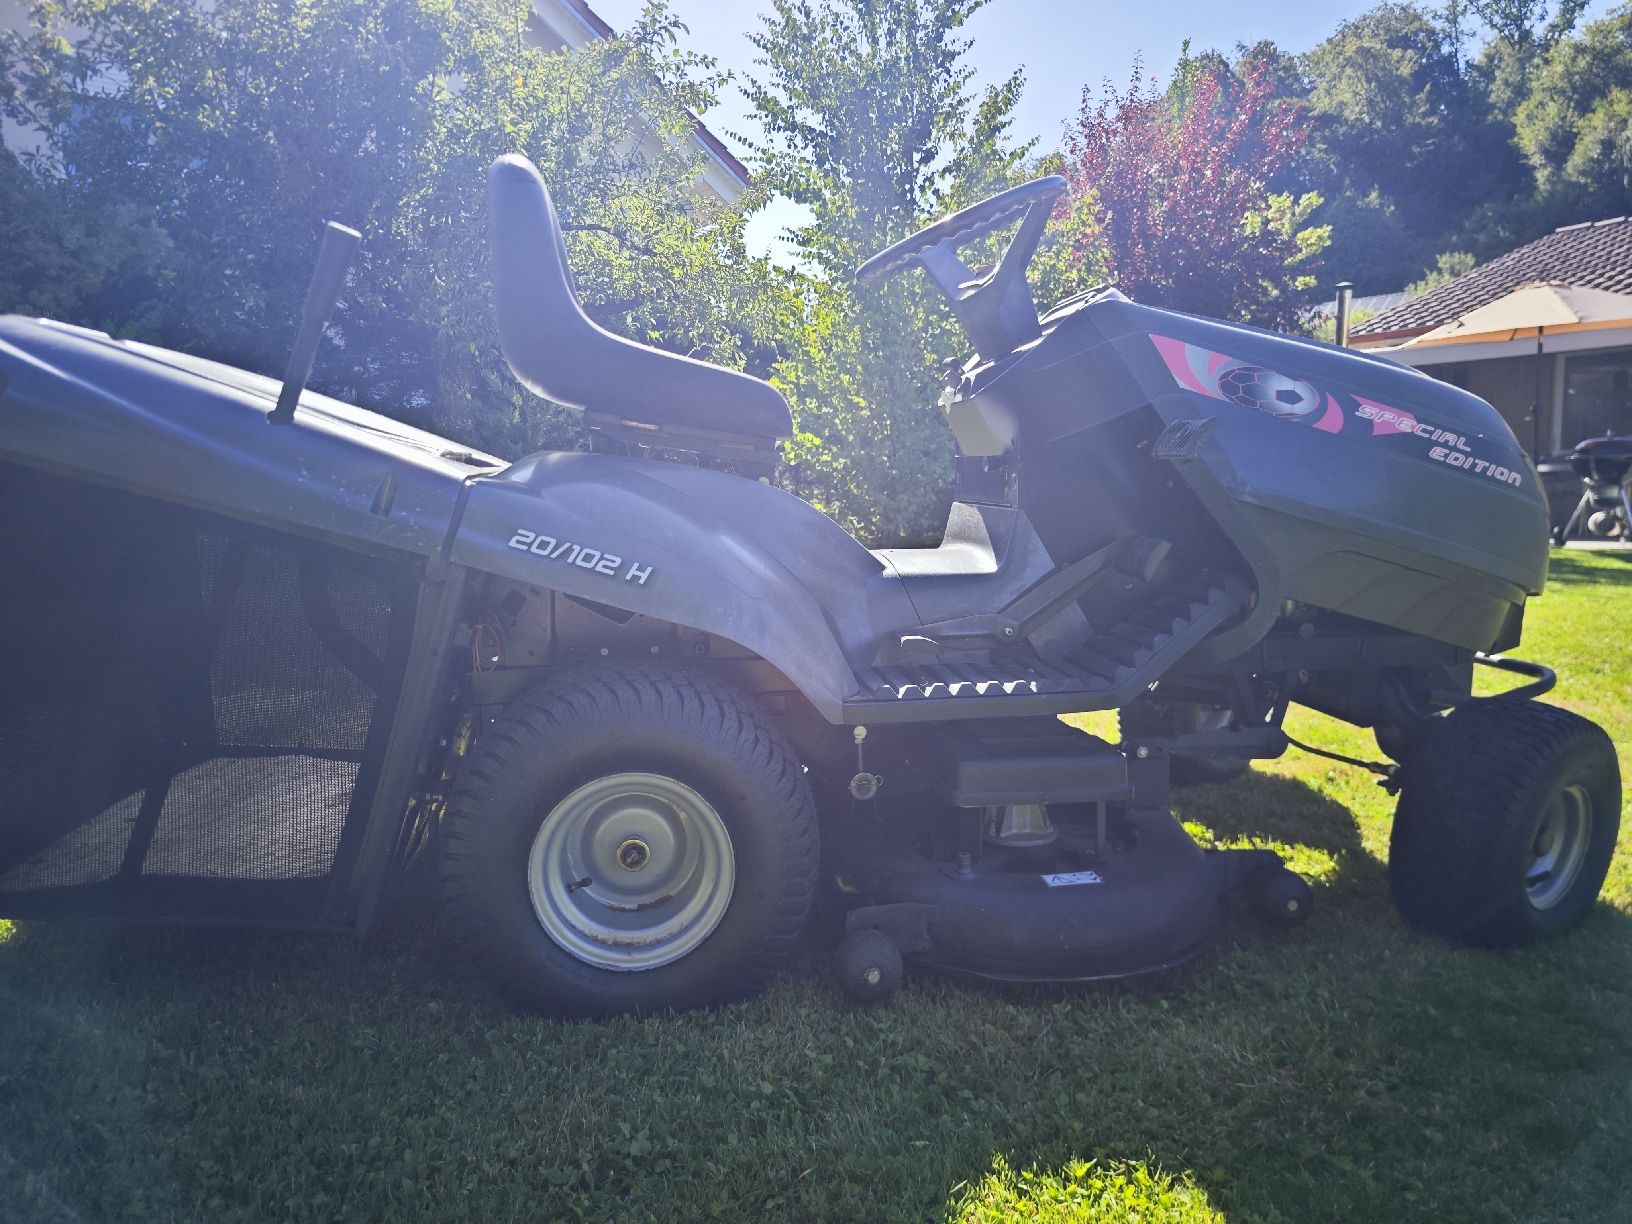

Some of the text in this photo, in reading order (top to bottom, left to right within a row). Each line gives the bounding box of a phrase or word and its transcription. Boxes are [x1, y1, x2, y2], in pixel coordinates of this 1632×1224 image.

[1355, 405, 1471, 451] SPECIAL
[1429, 446, 1522, 486] EDITION
[508, 528, 653, 585] 20/102 H
